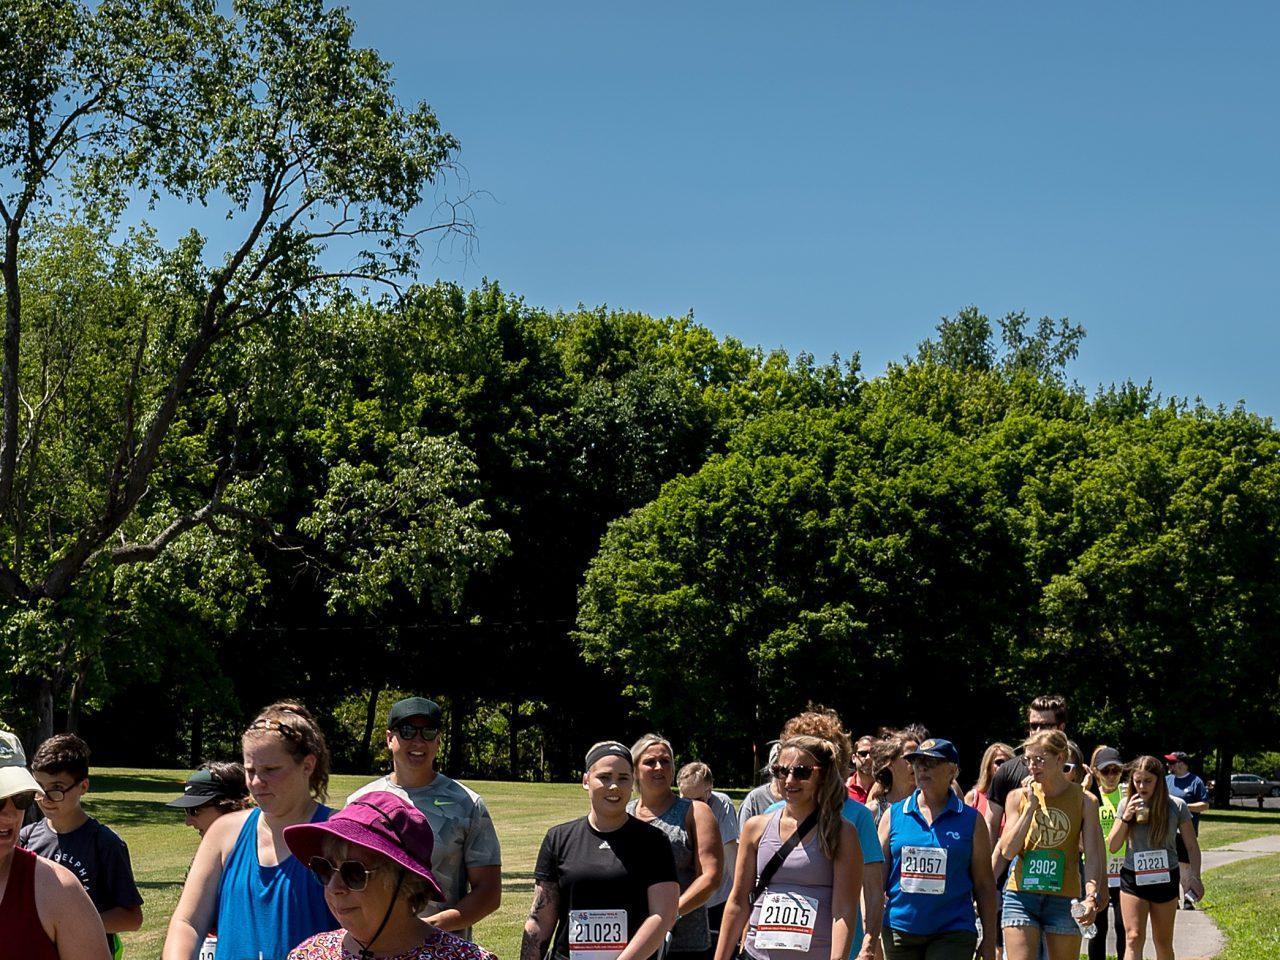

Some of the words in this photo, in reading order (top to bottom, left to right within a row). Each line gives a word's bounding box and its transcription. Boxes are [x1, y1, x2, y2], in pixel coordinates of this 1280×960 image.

[1101, 809, 1115, 820] CA
[53, 852, 90, 891] DELPHIA
[905, 856, 942, 873] 21057
[1029, 859, 1057, 875] 2902
[1138, 857, 1165, 870] 21221
[764, 906, 811, 926] 21015
[575, 922, 621, 942] 21023
